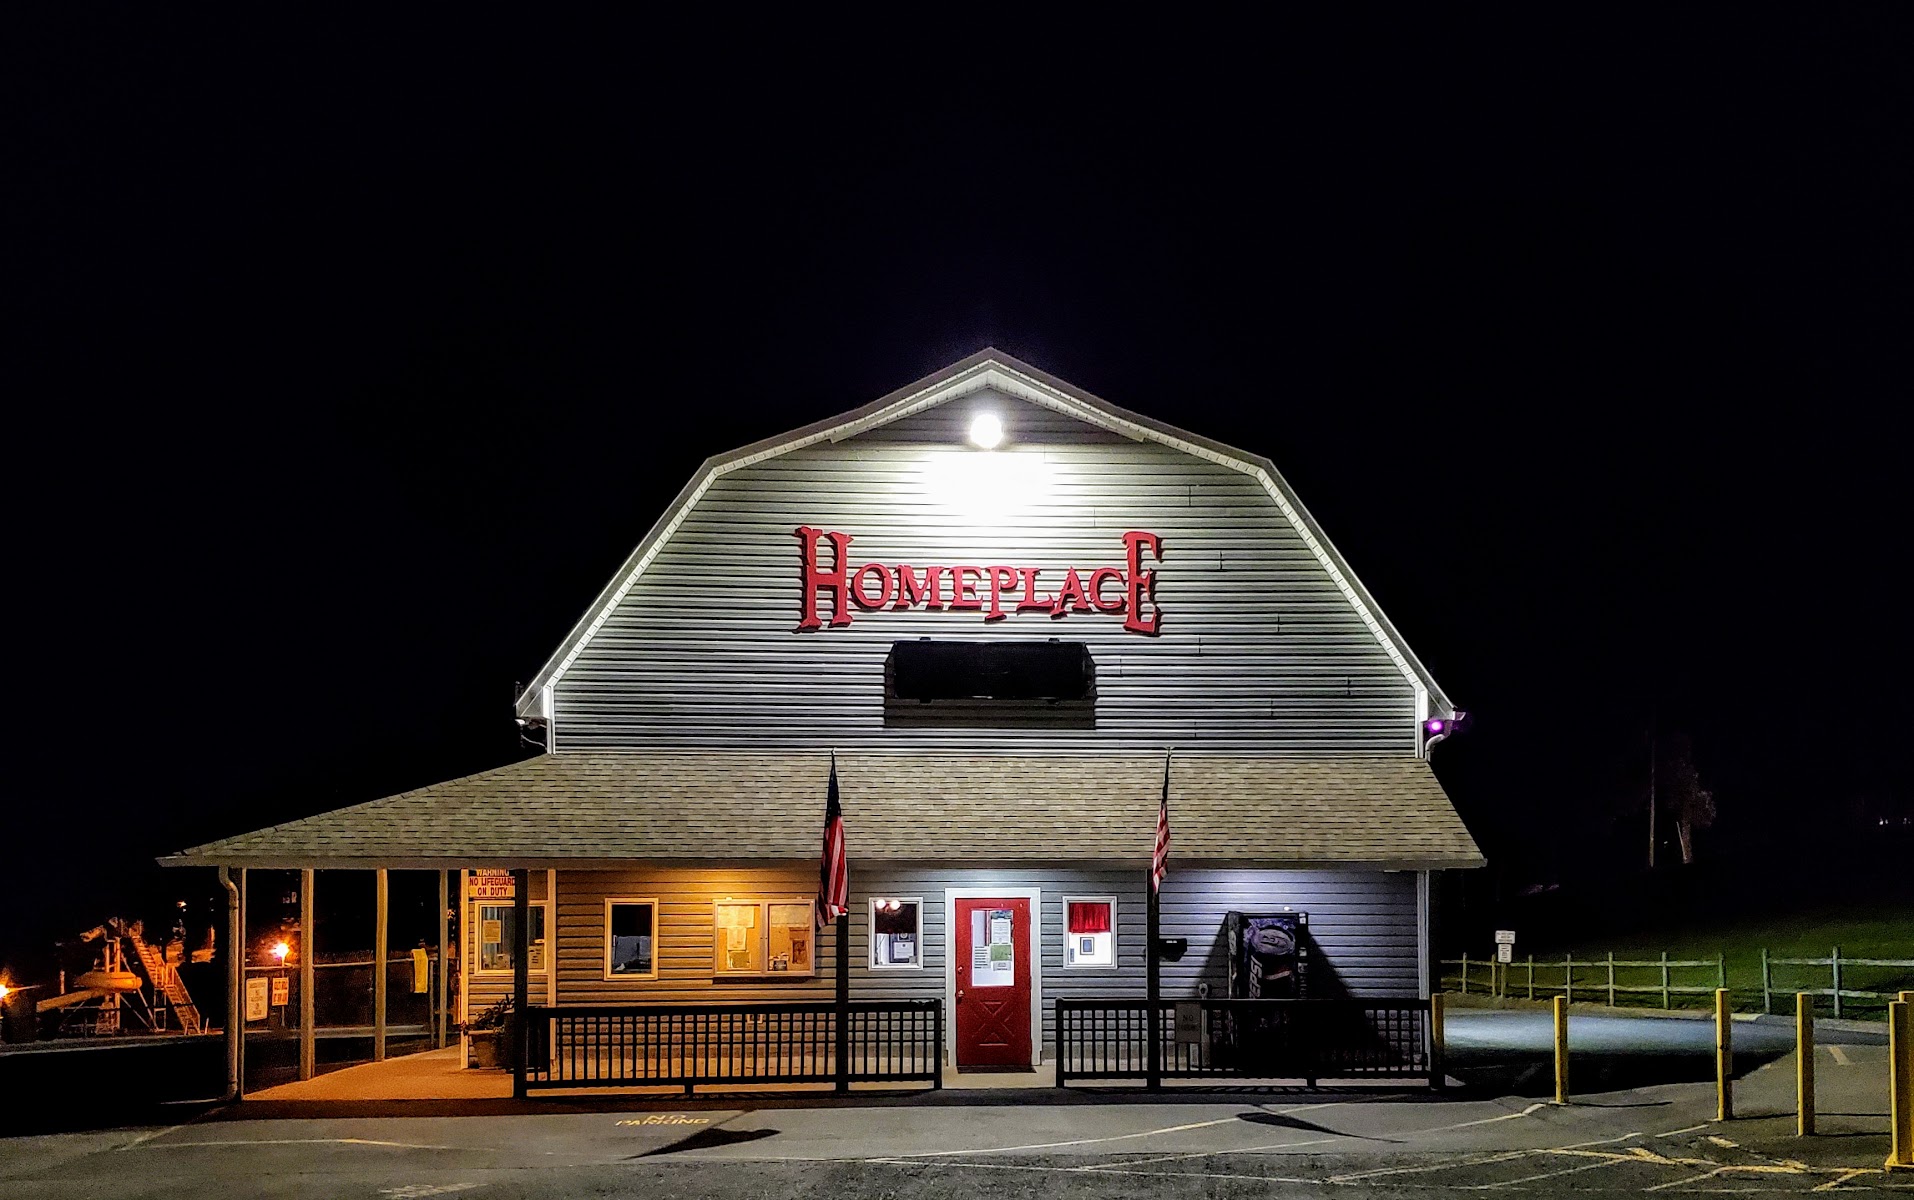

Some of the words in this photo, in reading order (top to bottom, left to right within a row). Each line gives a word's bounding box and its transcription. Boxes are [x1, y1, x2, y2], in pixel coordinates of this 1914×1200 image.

[794, 526, 1162, 635] HOMEPLACE
[476, 869, 509, 877] WARNING
[469, 877, 479, 886] NO
[481, 877, 515, 887] LIFEGUARD
[477, 887, 487, 896] ON
[490, 887, 508, 896] DUTY
[614, 1117, 710, 1126] PARKING
